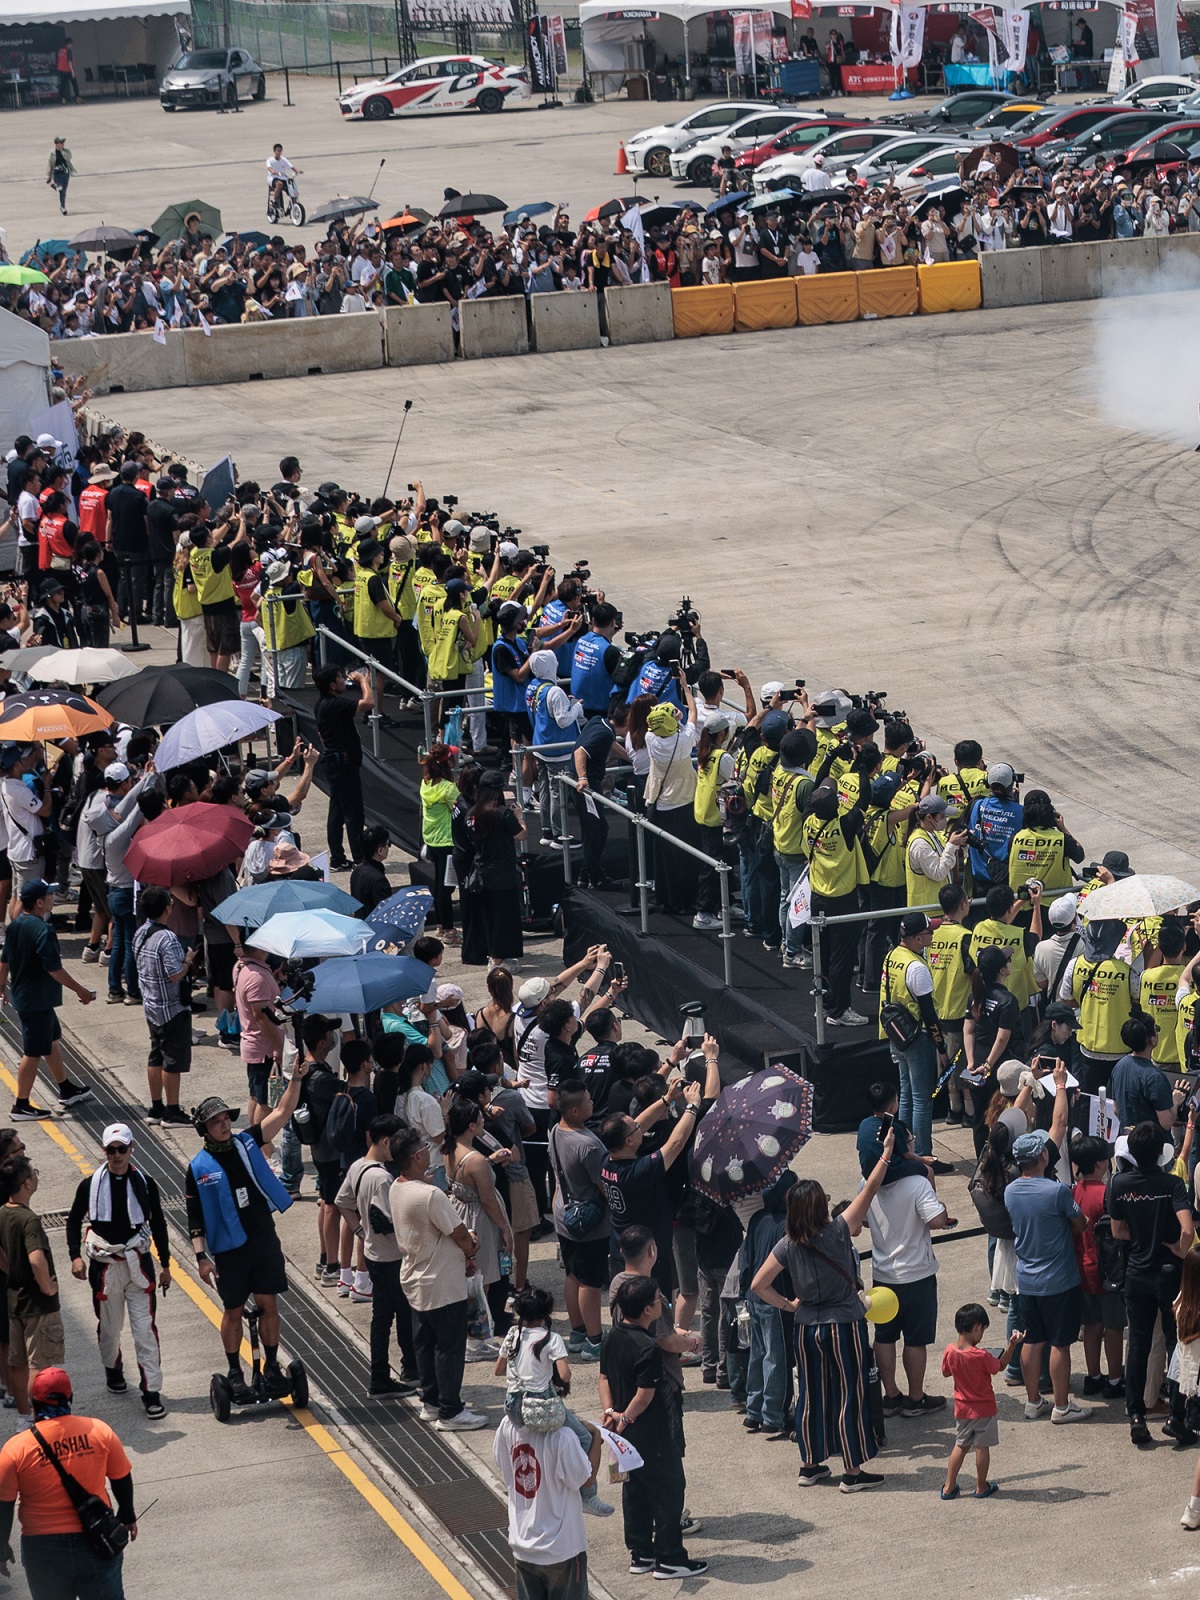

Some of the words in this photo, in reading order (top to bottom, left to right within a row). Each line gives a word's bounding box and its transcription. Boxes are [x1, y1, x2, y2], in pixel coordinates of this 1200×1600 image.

[981, 813, 1008, 823] MEDIA
[1014, 838, 1062, 847] MEDIA
[1018, 852, 1036, 861] GR
[973, 934, 1020, 945] MEDIA
[1076, 967, 1125, 981] MDIA
[1148, 996, 1166, 1005] GR
